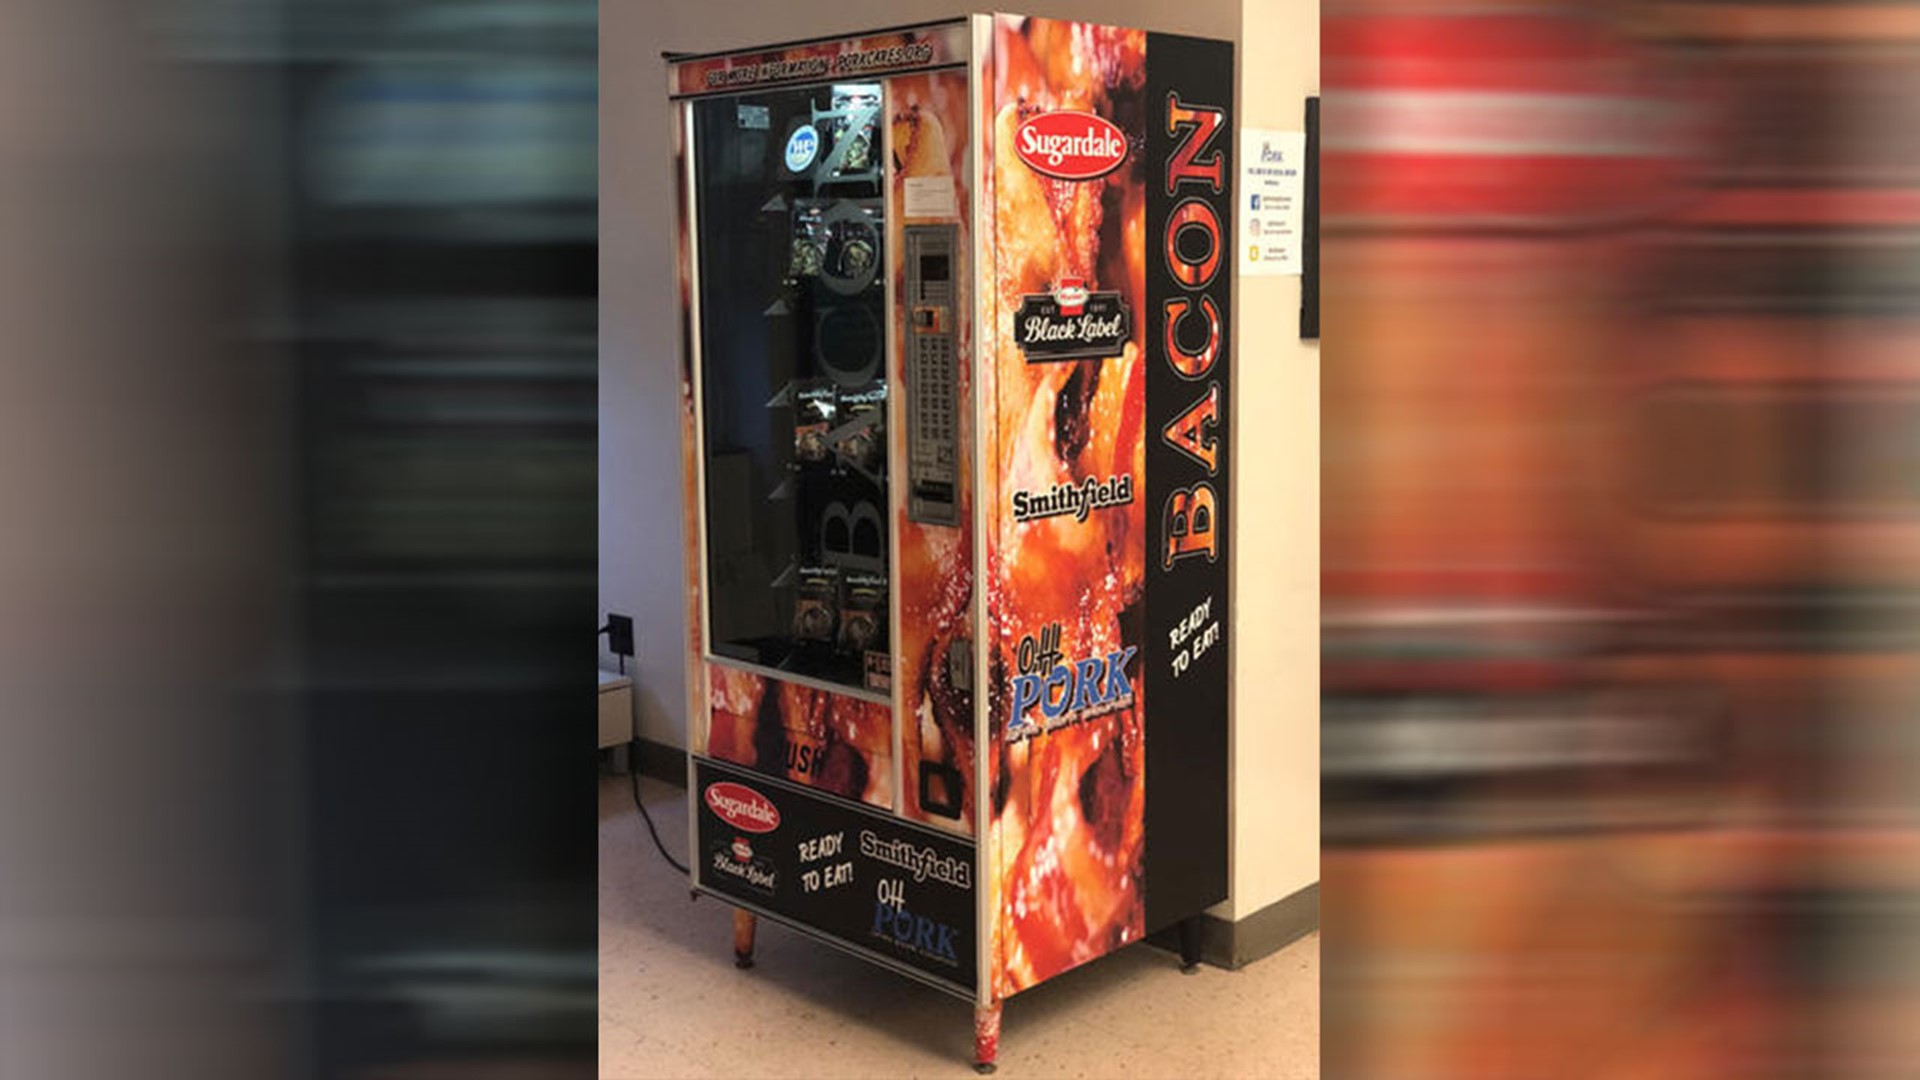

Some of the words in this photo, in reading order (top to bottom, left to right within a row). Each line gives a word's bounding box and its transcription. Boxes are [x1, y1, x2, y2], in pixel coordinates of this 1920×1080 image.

[1021, 126, 1121, 166] Sugardale
[1024, 315, 1076, 342] Black
[1076, 313, 1121, 342] Label
[1162, 91, 1225, 571] BACON
[1012, 476, 1134, 523] Smithfield
[1169, 596, 1212, 650] READY
[1171, 649, 1190, 678] TO
[1193, 621, 1220, 660] EAT!
[1008, 647, 1137, 729] PORK
[710, 788, 776, 825] Sugardale
[799, 832, 844, 862] READY
[860, 830, 972, 889] Smithfield
[802, 870, 820, 893] TO
[824, 862, 853, 888] EAT!
[877, 879, 905, 913] OH
[874, 902, 958, 960] PORK
